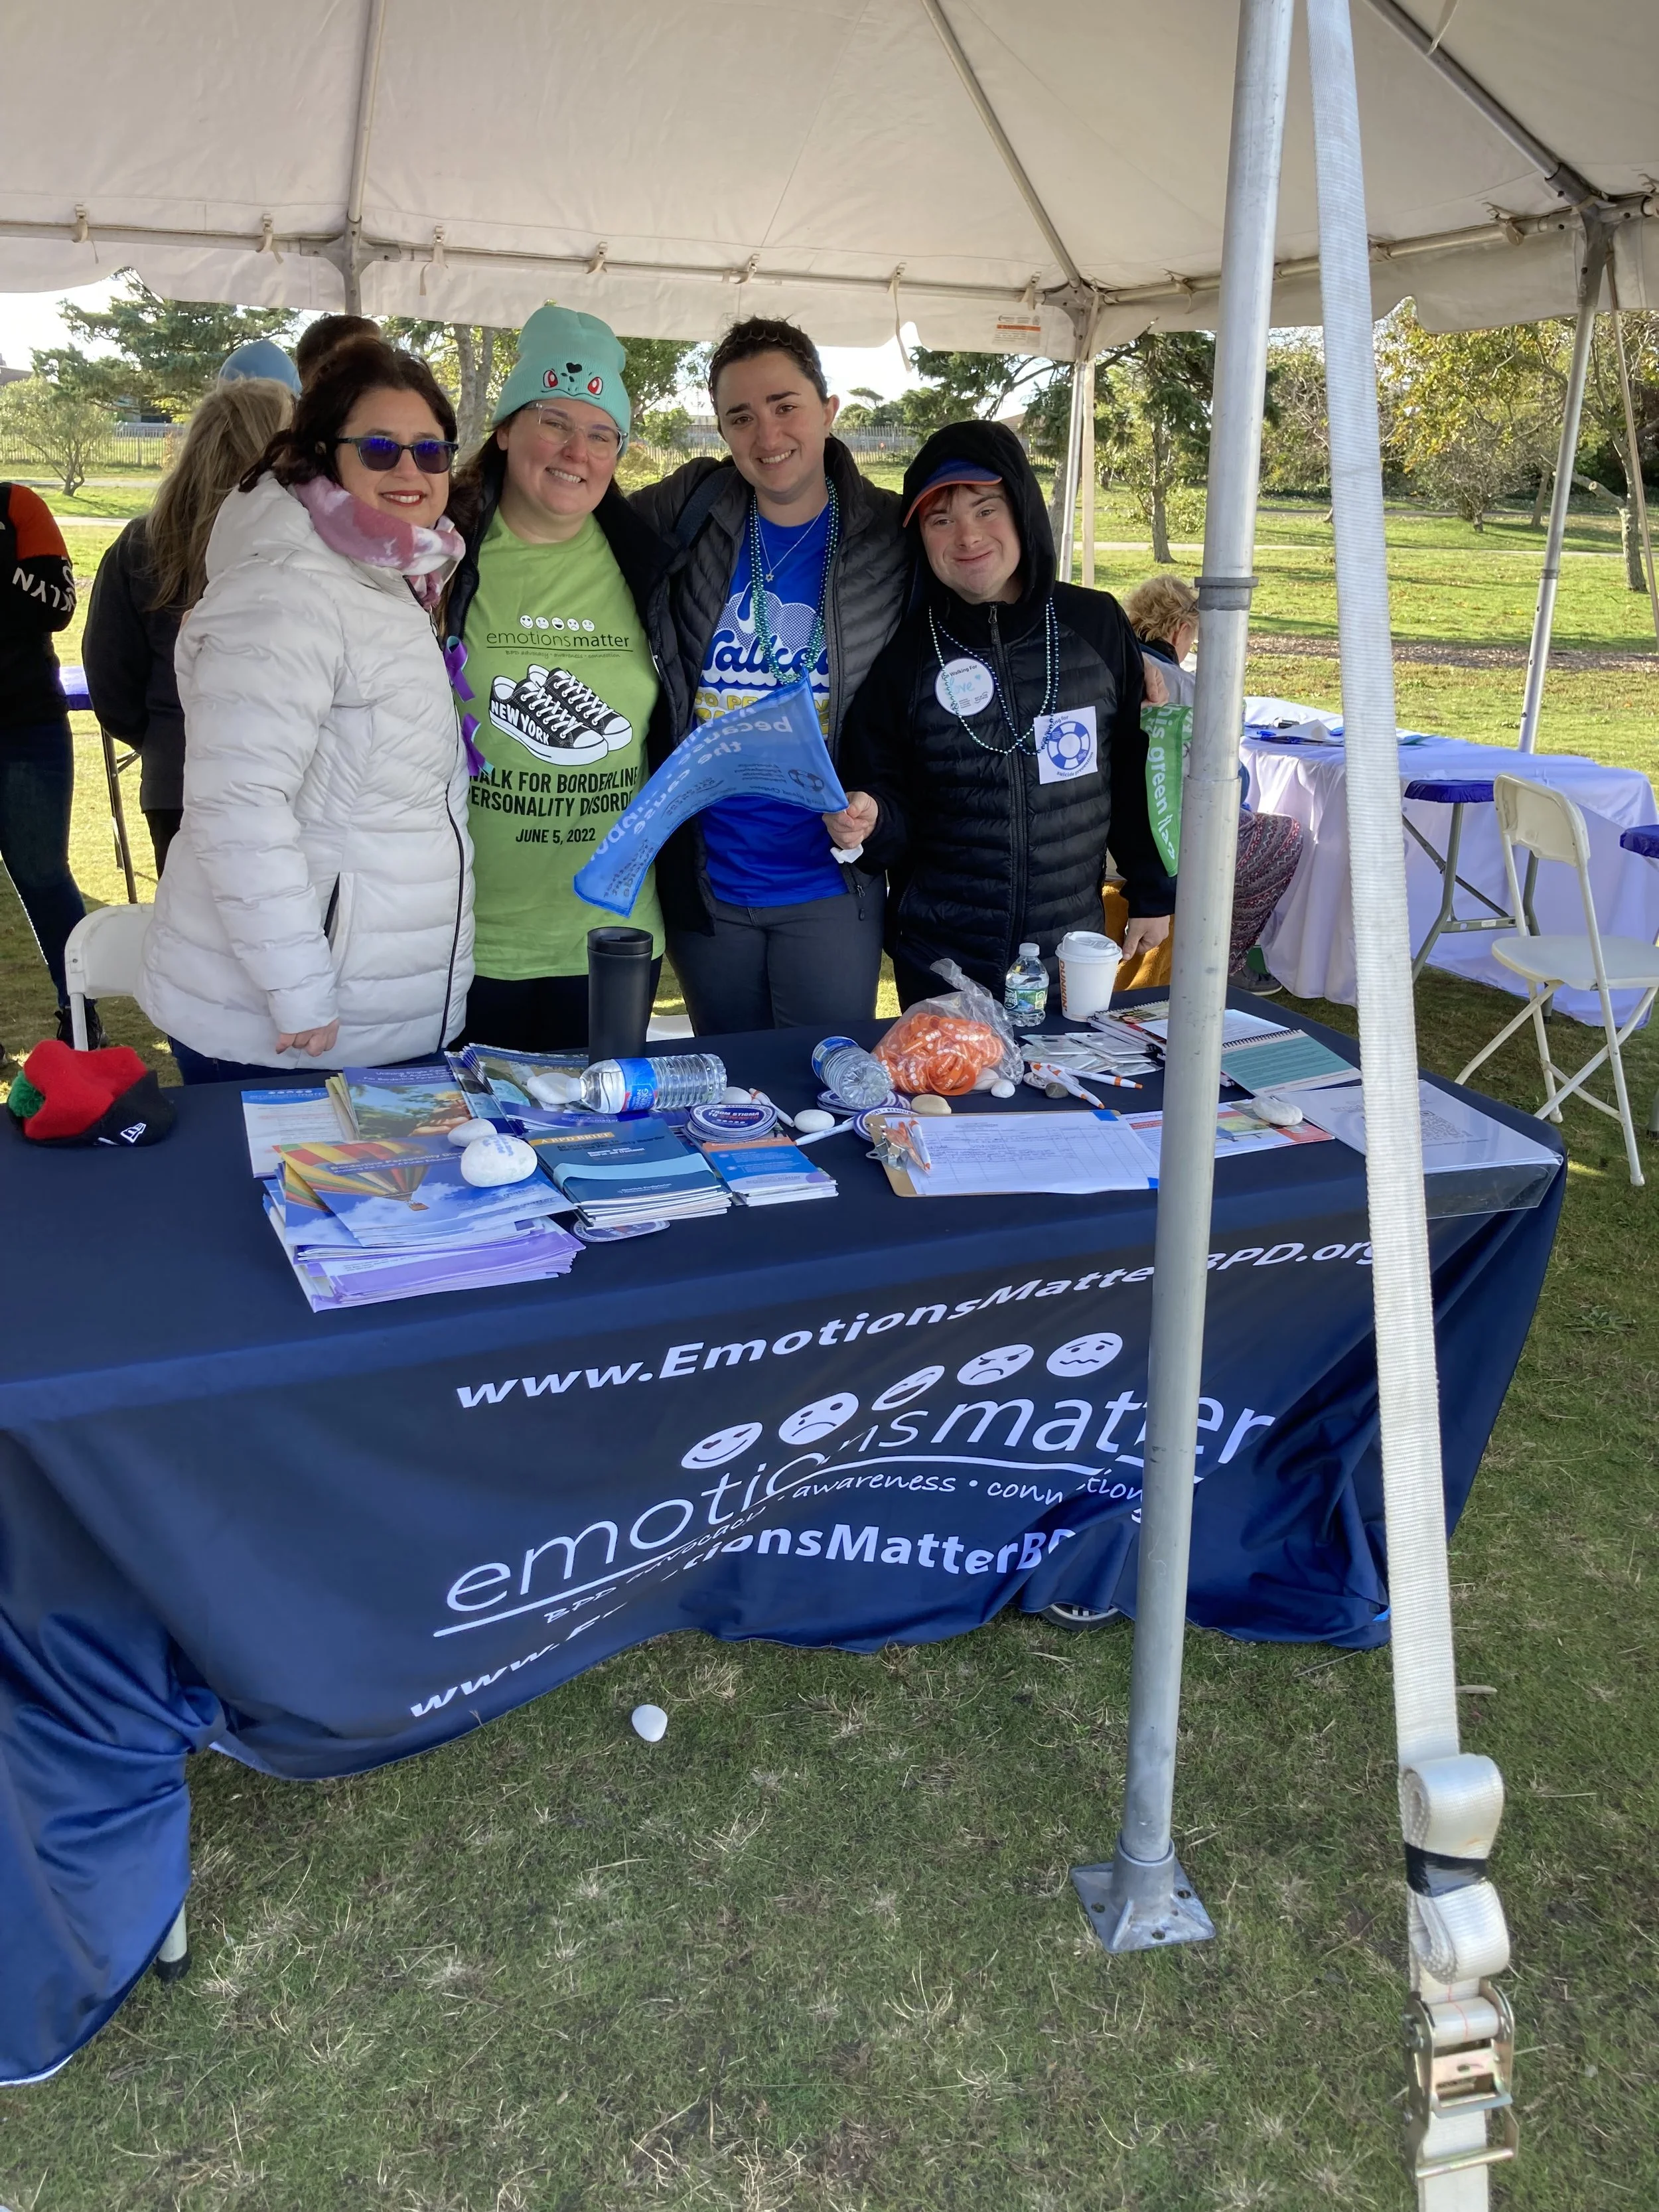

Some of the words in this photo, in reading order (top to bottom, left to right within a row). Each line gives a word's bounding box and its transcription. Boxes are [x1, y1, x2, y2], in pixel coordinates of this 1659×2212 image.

[950, 668, 970, 677] Walking
[491, 700, 520, 727] NEW
[521, 713, 549, 745] YORK
[1152, 703, 1182, 739] his
[1075, 751, 1094, 775] prevention
[519, 771, 551, 793] FOR
[557, 767, 638, 794] BORDERLINE
[1147, 746, 1168, 815] green
[467, 785, 575, 817] ERSONALITY
[579, 790, 633, 817] DISORD
[516, 829, 549, 843] JUNE
[553, 830, 563, 845] 5,
[566, 828, 596, 842] 2022
[577, 1132, 611, 1142] BRIEF
[457, 1242, 1372, 1408] www.EmotionsMatteBPD.org
[543, 1587, 617, 1624] BPD
[792, 1471, 956, 1499] awareness
[986, 1467, 1143, 1504] conntion
